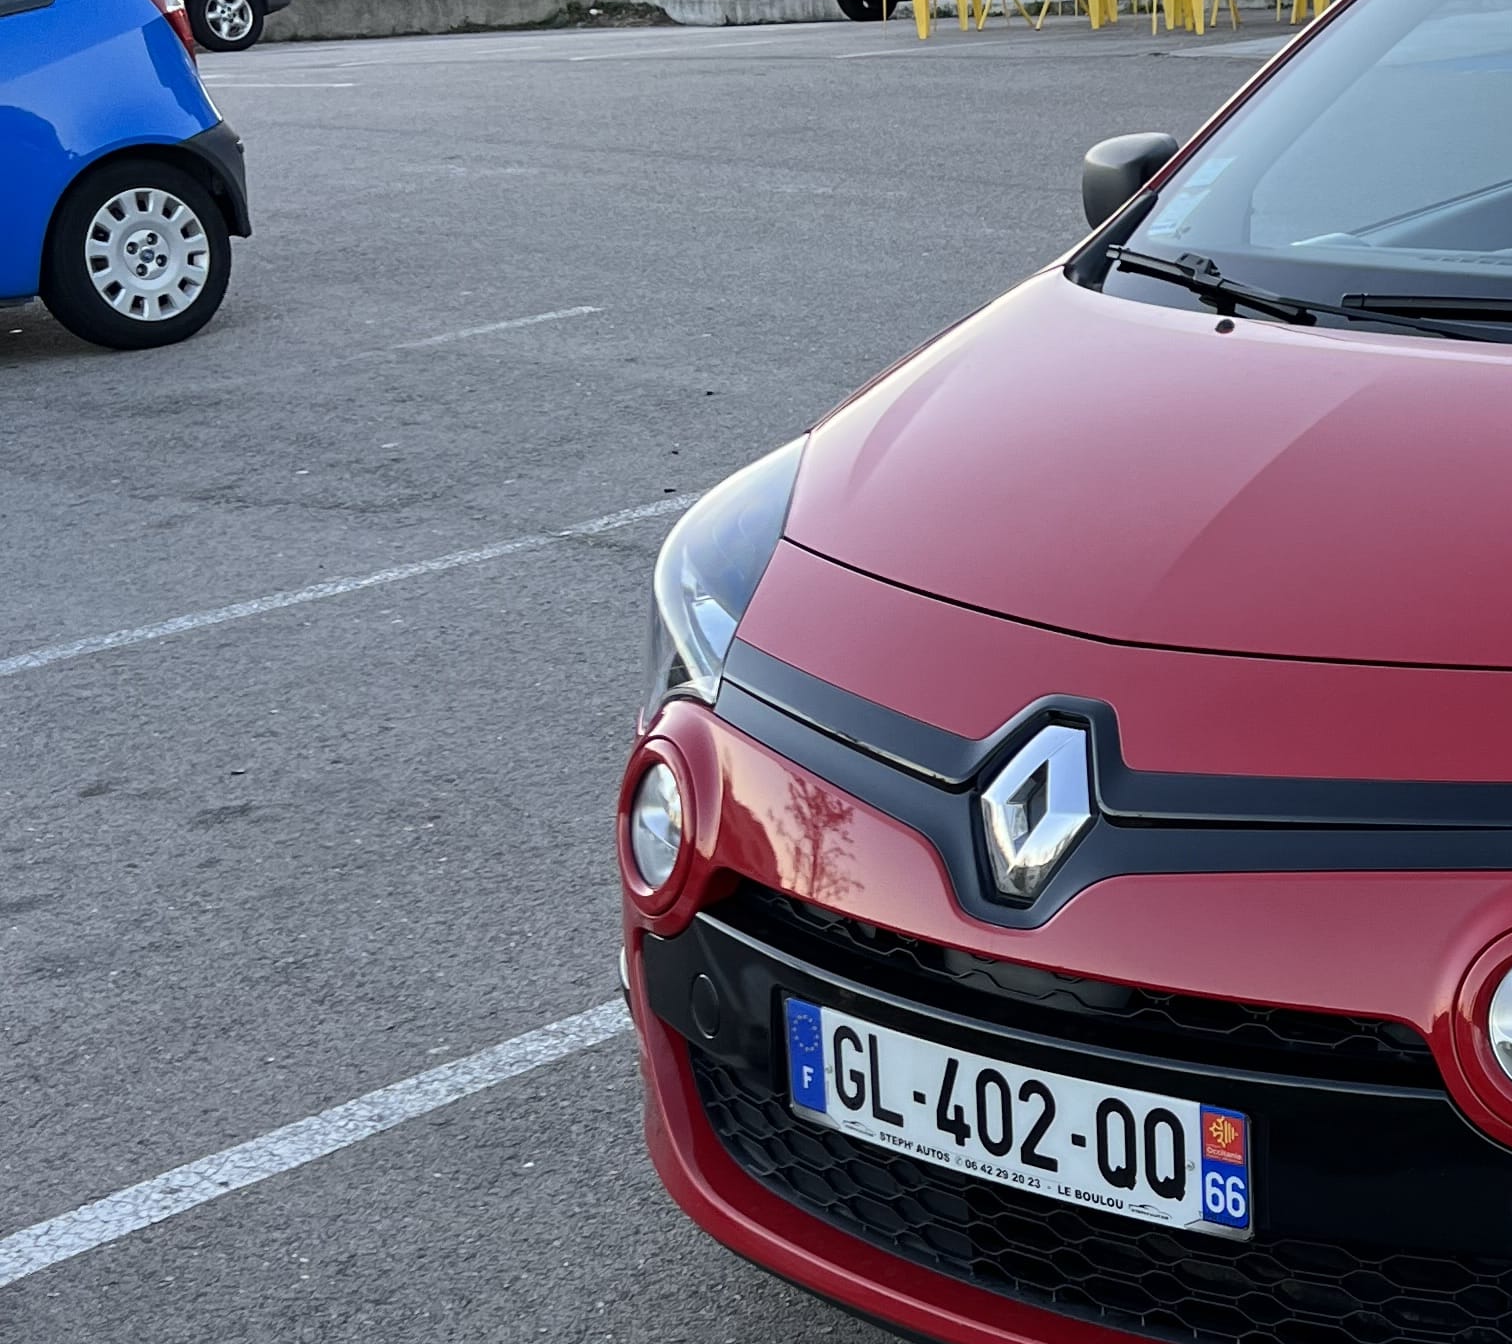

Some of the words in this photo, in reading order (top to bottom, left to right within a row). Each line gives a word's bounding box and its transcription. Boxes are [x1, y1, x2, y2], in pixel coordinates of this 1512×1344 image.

[802, 1065, 814, 1088] F
[833, 1025, 1186, 1201] GL-402-QQ
[916, 1144, 950, 1163] AUTOS
[965, 1159, 978, 1170] 06
[980, 1163, 993, 1175] 42
[996, 1167, 1009, 1179] 29
[1011, 1172, 1024, 1184] 20
[1027, 1177, 1041, 1189] 23
[1057, 1184, 1071, 1196] LE
[1075, 1189, 1124, 1209] BOULOU
[1205, 1171, 1246, 1218] 66
